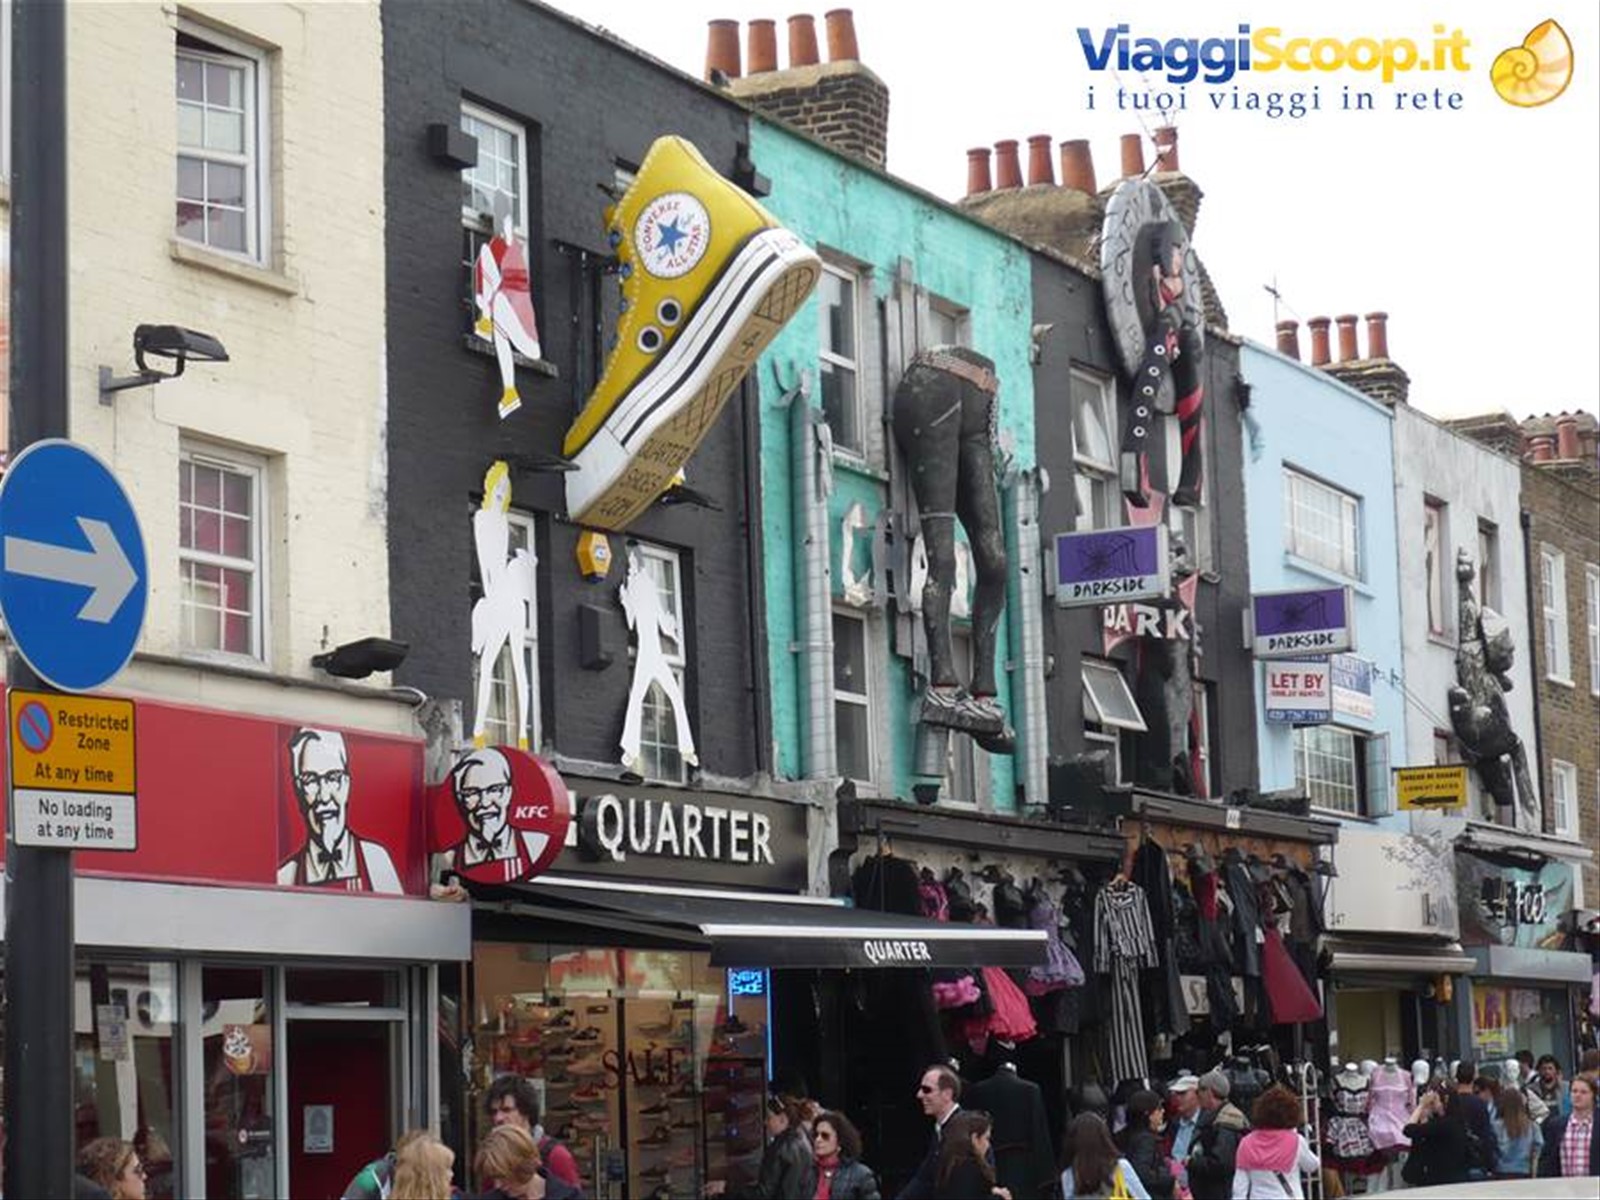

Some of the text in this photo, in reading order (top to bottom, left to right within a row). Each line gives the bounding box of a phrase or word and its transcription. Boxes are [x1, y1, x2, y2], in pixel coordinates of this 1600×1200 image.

[642, 201, 681, 253] CONVERSE
[665, 255, 689, 269] ALL
[686, 224, 702, 257] STAR
[1073, 578, 1146, 597] DARKSIDE
[1268, 632, 1335, 650] DARKSIDE
[1271, 673, 1323, 688] LET BY
[58, 710, 129, 732] Restricted
[77, 732, 110, 751] Zone
[35, 762, 114, 784] At any time
[38, 798, 112, 822] No loading
[514, 805, 549, 819] KFC
[37, 822, 114, 841] at any time
[596, 793, 776, 865] QUARTER
[864, 940, 932, 965] QUARTER
